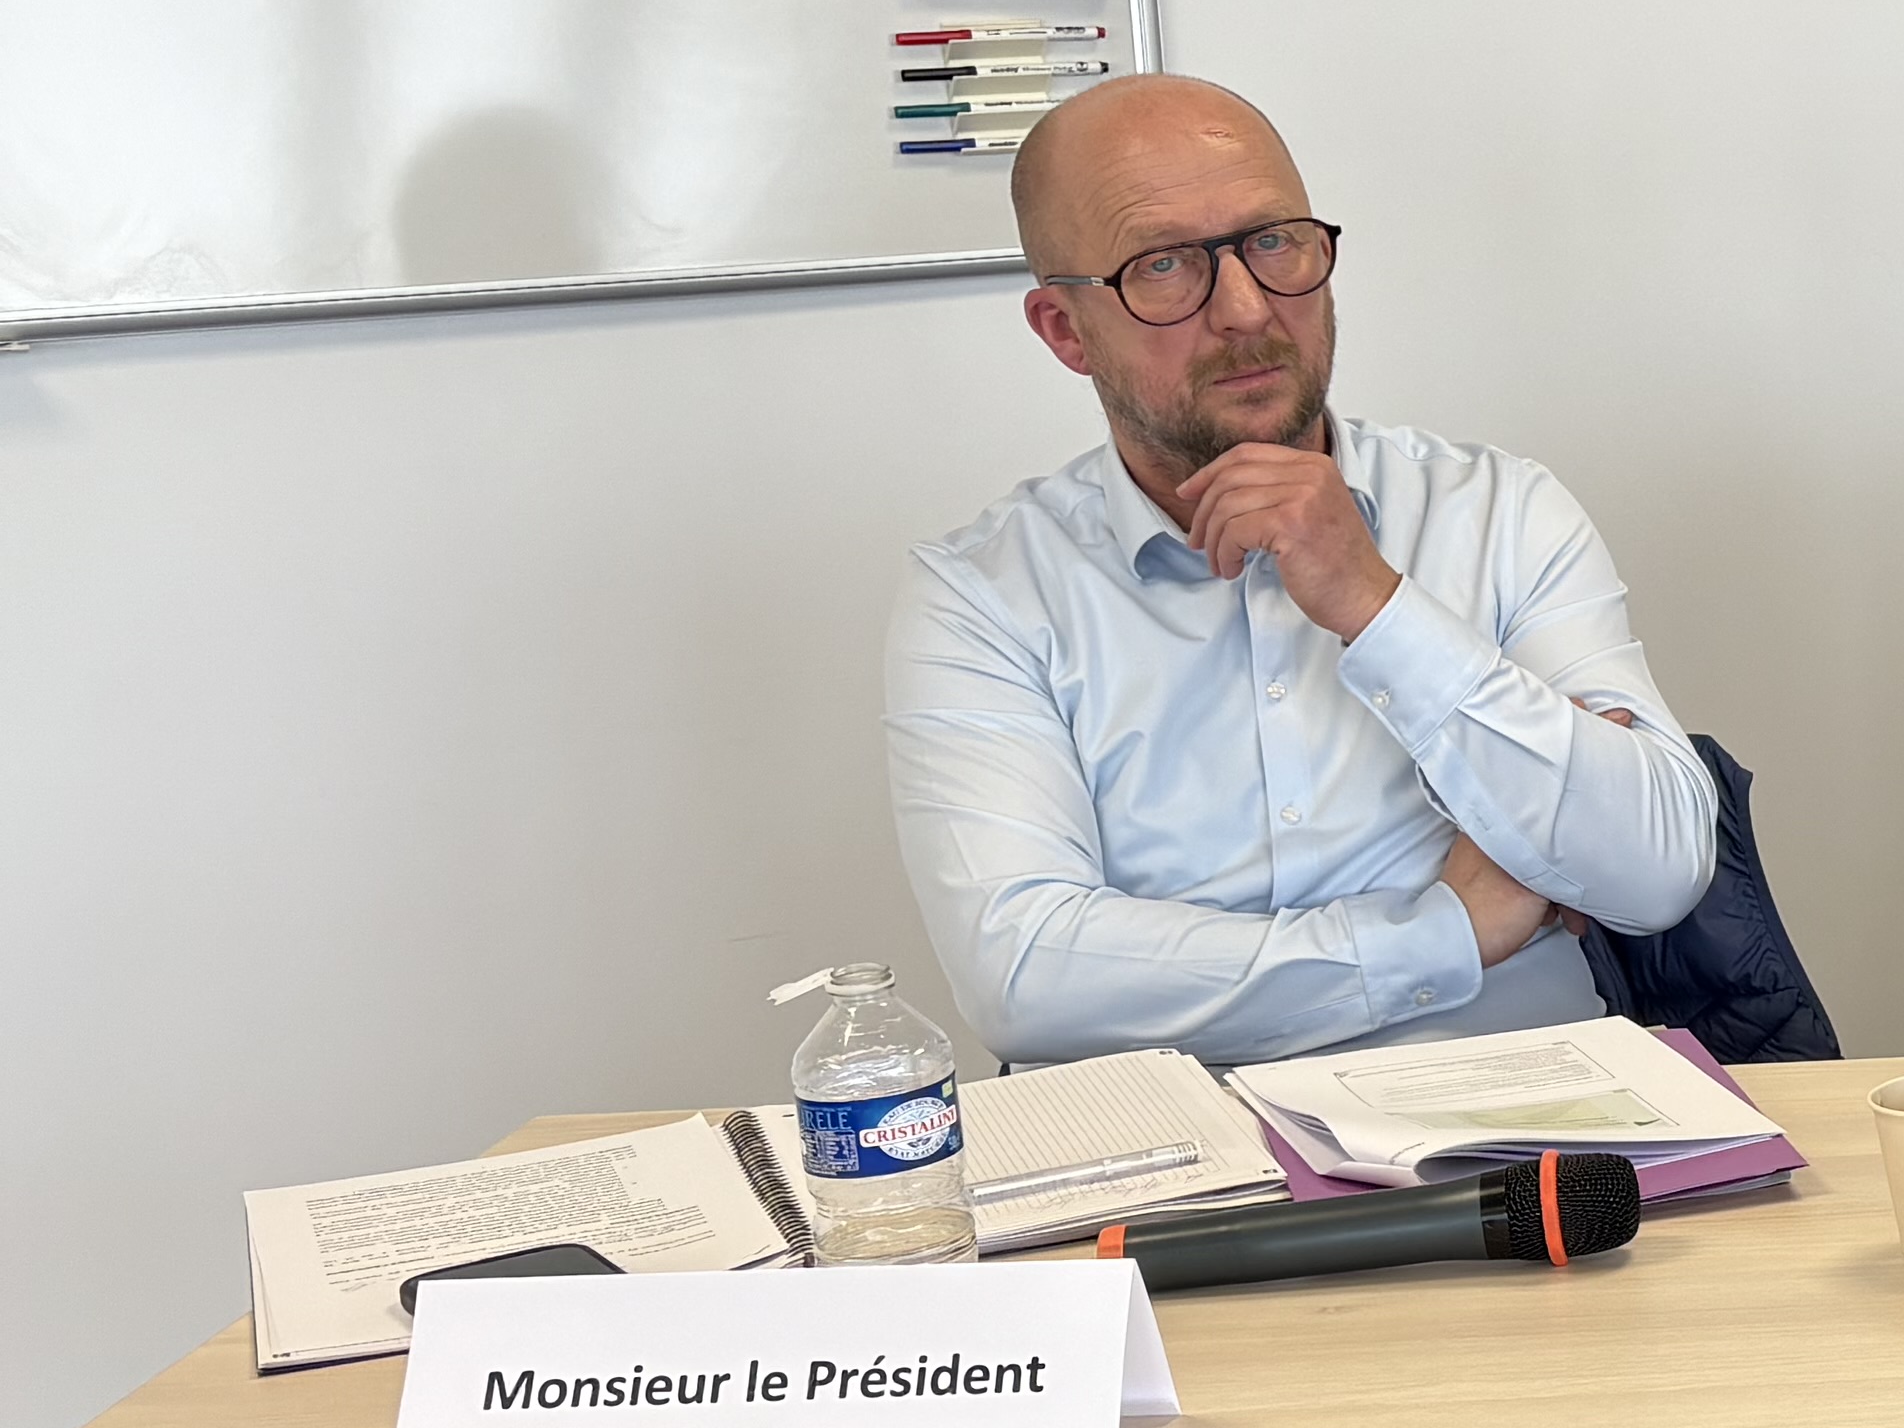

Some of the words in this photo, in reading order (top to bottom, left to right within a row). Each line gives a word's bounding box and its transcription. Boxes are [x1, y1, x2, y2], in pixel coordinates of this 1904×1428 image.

[483, 1367, 731, 1411] Monsieur
[747, 1360, 787, 1403] le
[806, 1353, 1046, 1401] Président
